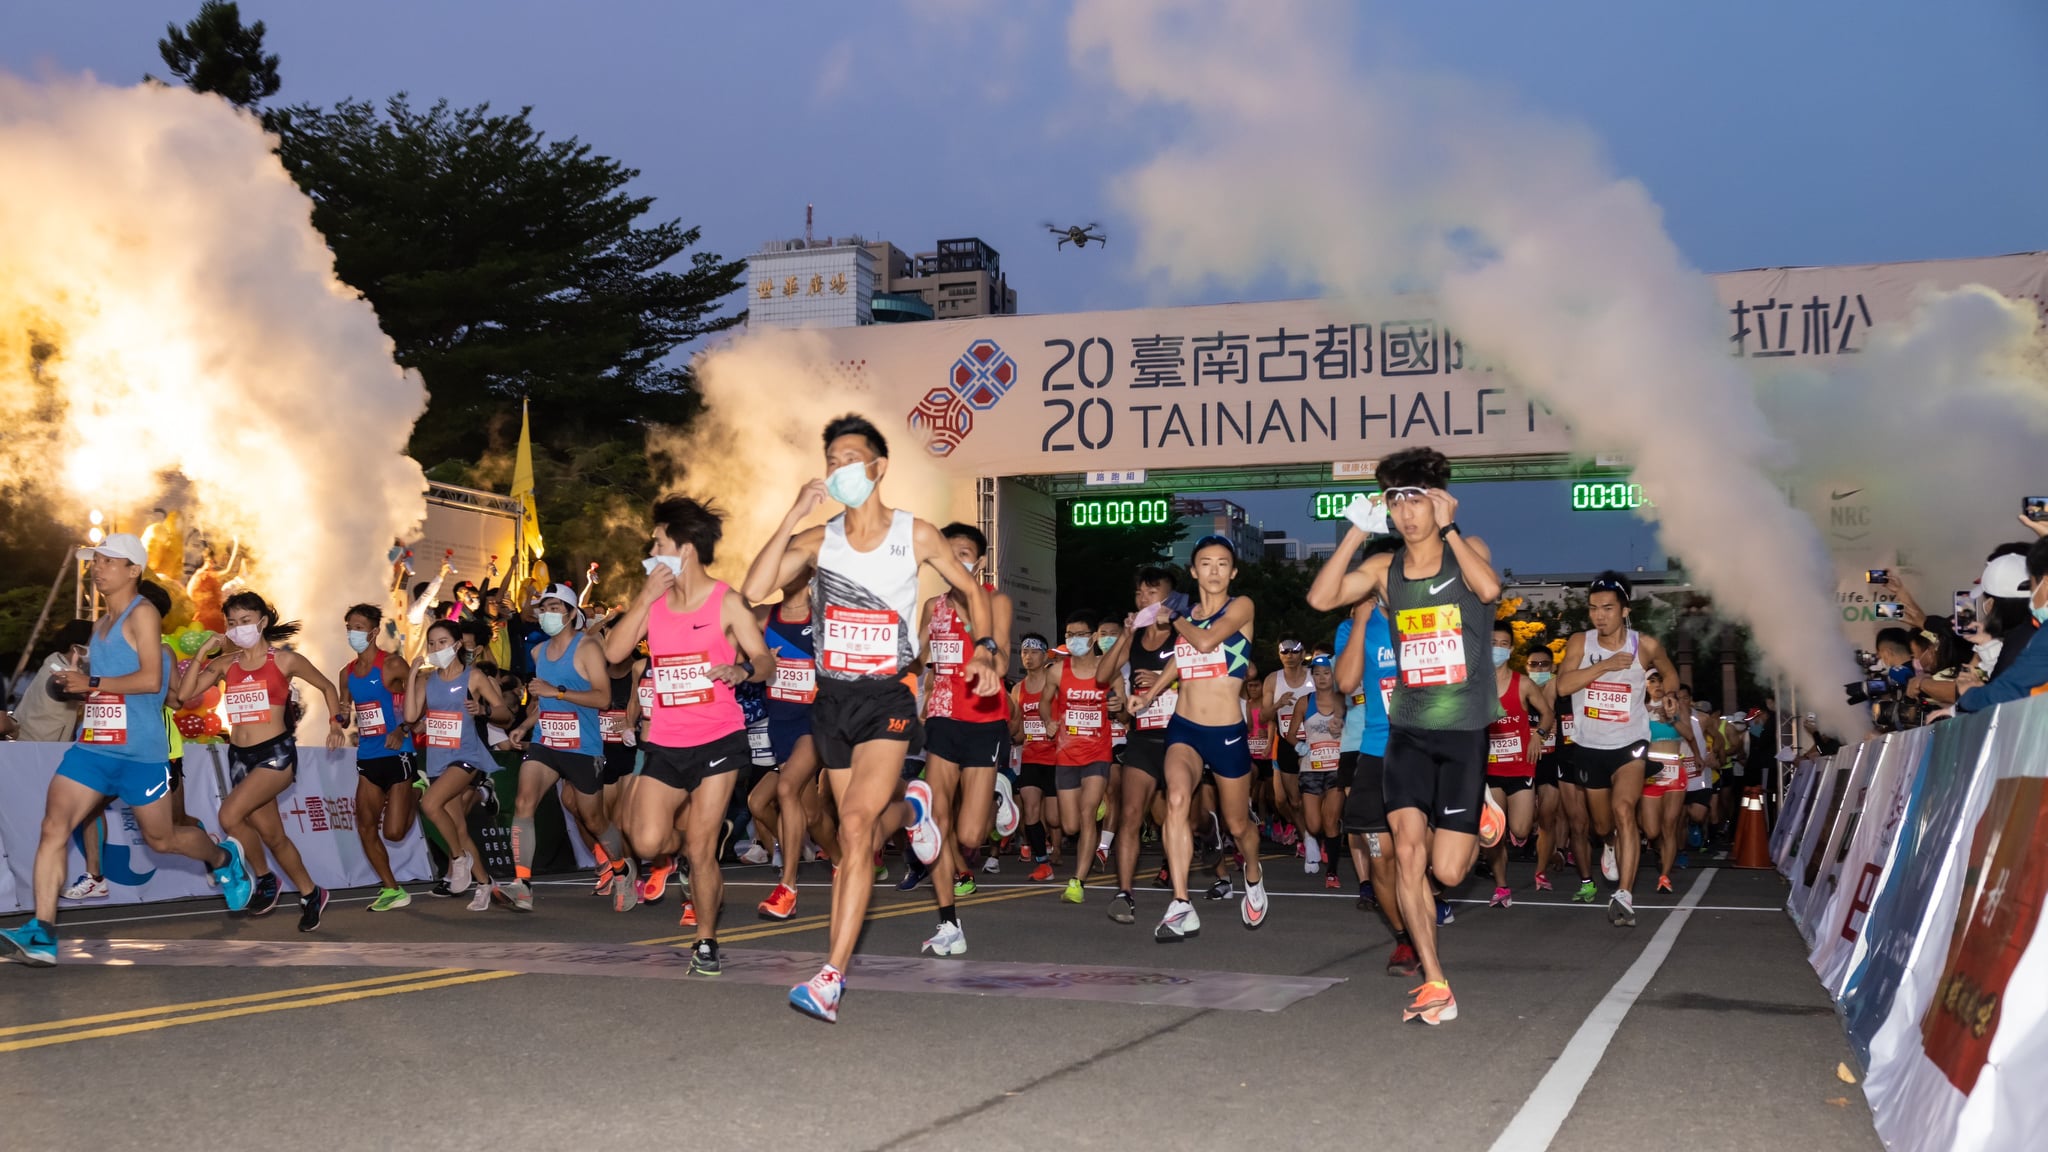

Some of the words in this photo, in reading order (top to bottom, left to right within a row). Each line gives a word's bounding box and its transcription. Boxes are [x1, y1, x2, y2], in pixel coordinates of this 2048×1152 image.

[757, 272, 848, 300] 世華廣場
[1042, 336, 1114, 392] 20
[1042, 397, 1114, 452] 20
[1129, 396, 1336, 449] TAINAN
[1360, 388, 1506, 441] HALF
[1831, 506, 1871, 526] NRC
[829, 623, 891, 641] E17170
[658, 665, 705, 681] F14564
[776, 669, 809, 681] 12931
[226, 691, 265, 705] E20650
[1067, 688, 1104, 700] tsmc
[1587, 690, 1628, 703] E13486
[86, 705, 121, 718] E10305
[1023, 701, 1040, 713] tsm
[1068, 711, 1099, 721] E10982
[428, 719, 458, 731] E20651
[541, 720, 577, 731] E10306
[1491, 738, 1518, 748] 13238
